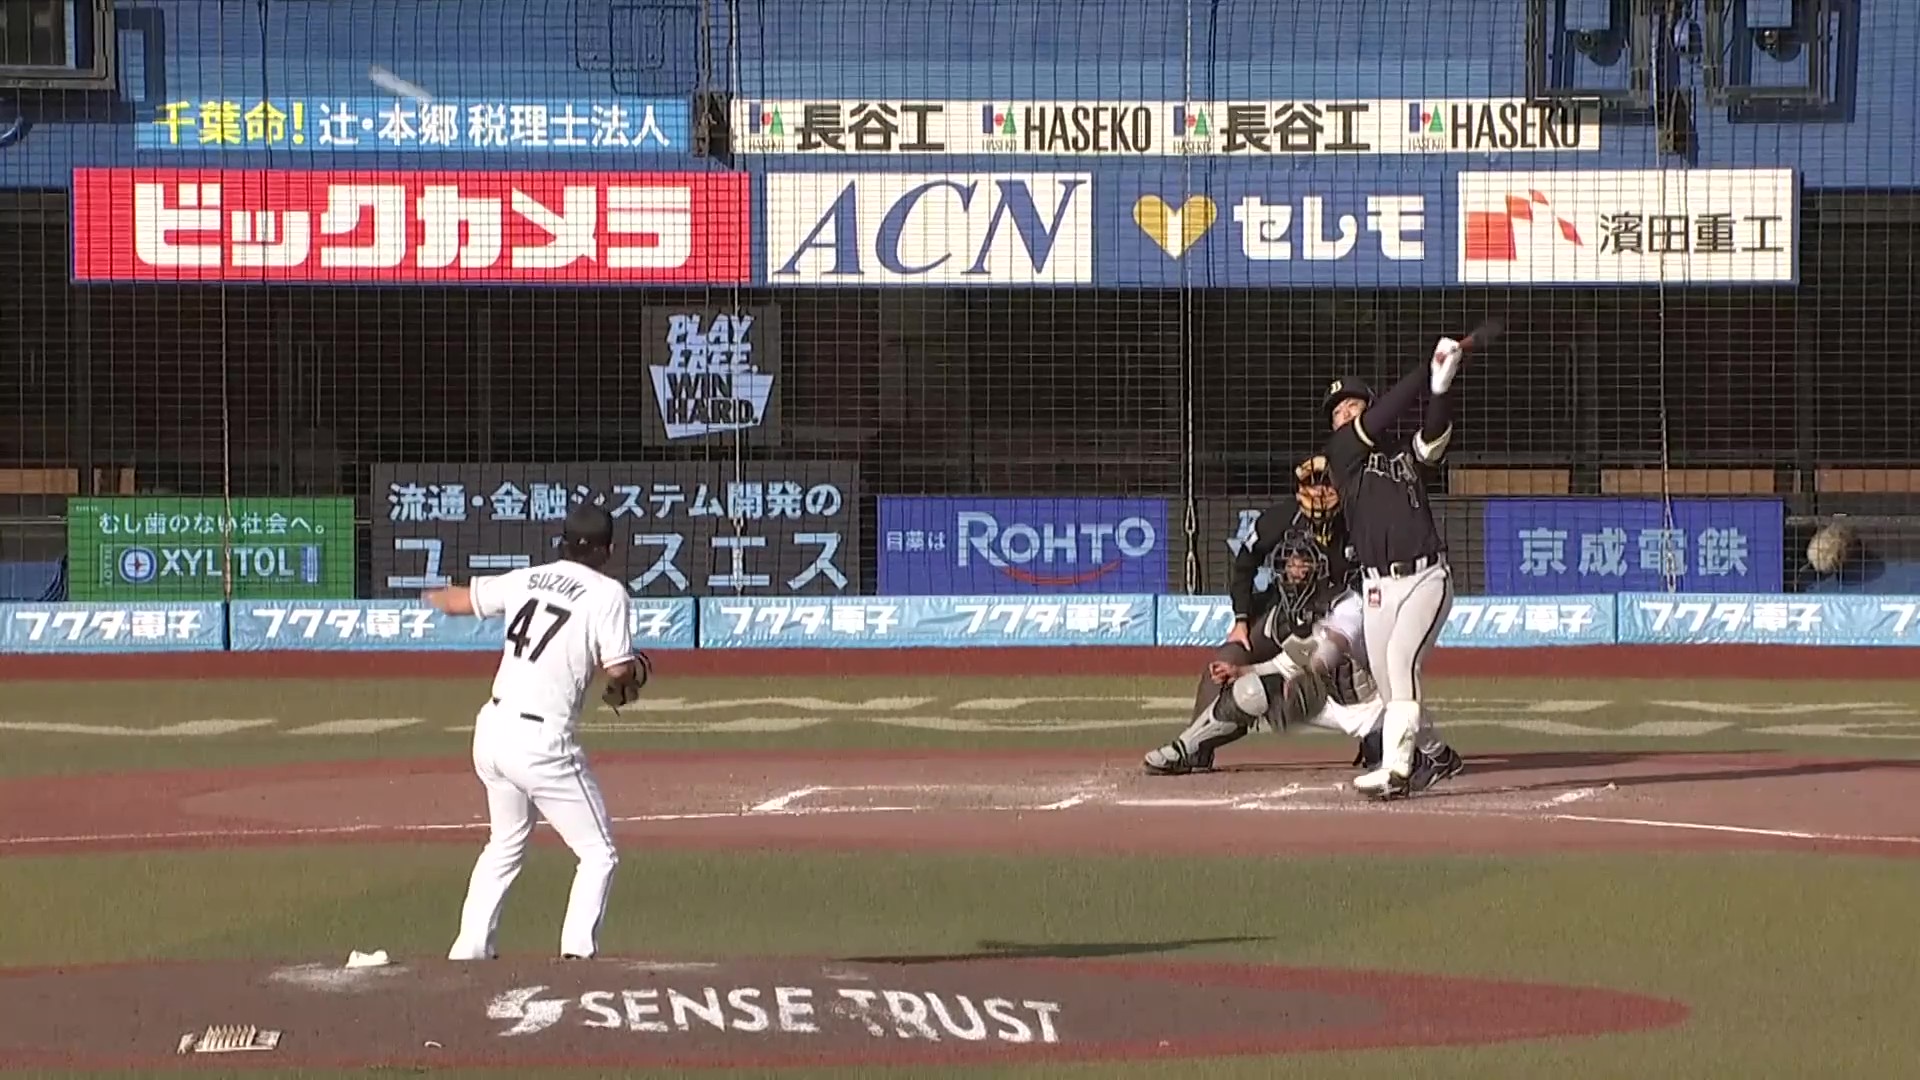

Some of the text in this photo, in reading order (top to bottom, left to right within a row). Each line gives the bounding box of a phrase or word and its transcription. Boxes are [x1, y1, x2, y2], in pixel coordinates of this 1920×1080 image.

[152, 101, 670, 147] 千葉命! 辻・本郷 税理士法人
[795, 103, 945, 152] 長谷工
[1024, 106, 1151, 152] HASEKO
[1220, 103, 1371, 152] 長谷工
[1451, 102, 1580, 149] HASEKO
[134, 182, 692, 268] ビックカメラ
[774, 178, 1088, 275] ACN
[1234, 195, 1425, 260] セレモ
[1600, 211, 1785, 254] 濱田重工
[666, 313, 755, 344] PLAY
[667, 372, 733, 399] WIN
[666, 398, 759, 424] HARD.
[160, 547, 295, 577] XYLTOL
[388, 532, 848, 592] ユースエス
[887, 530, 946, 551] 目薬は
[958, 511, 1155, 567] ROHTO
[1519, 526, 1748, 577] 京成電鉄
[527, 573, 587, 602] SUZUKI
[507, 597, 571, 664] 47
[1448, 605, 1593, 634] クダ電子
[579, 986, 1061, 1044] SENSE TRUST
